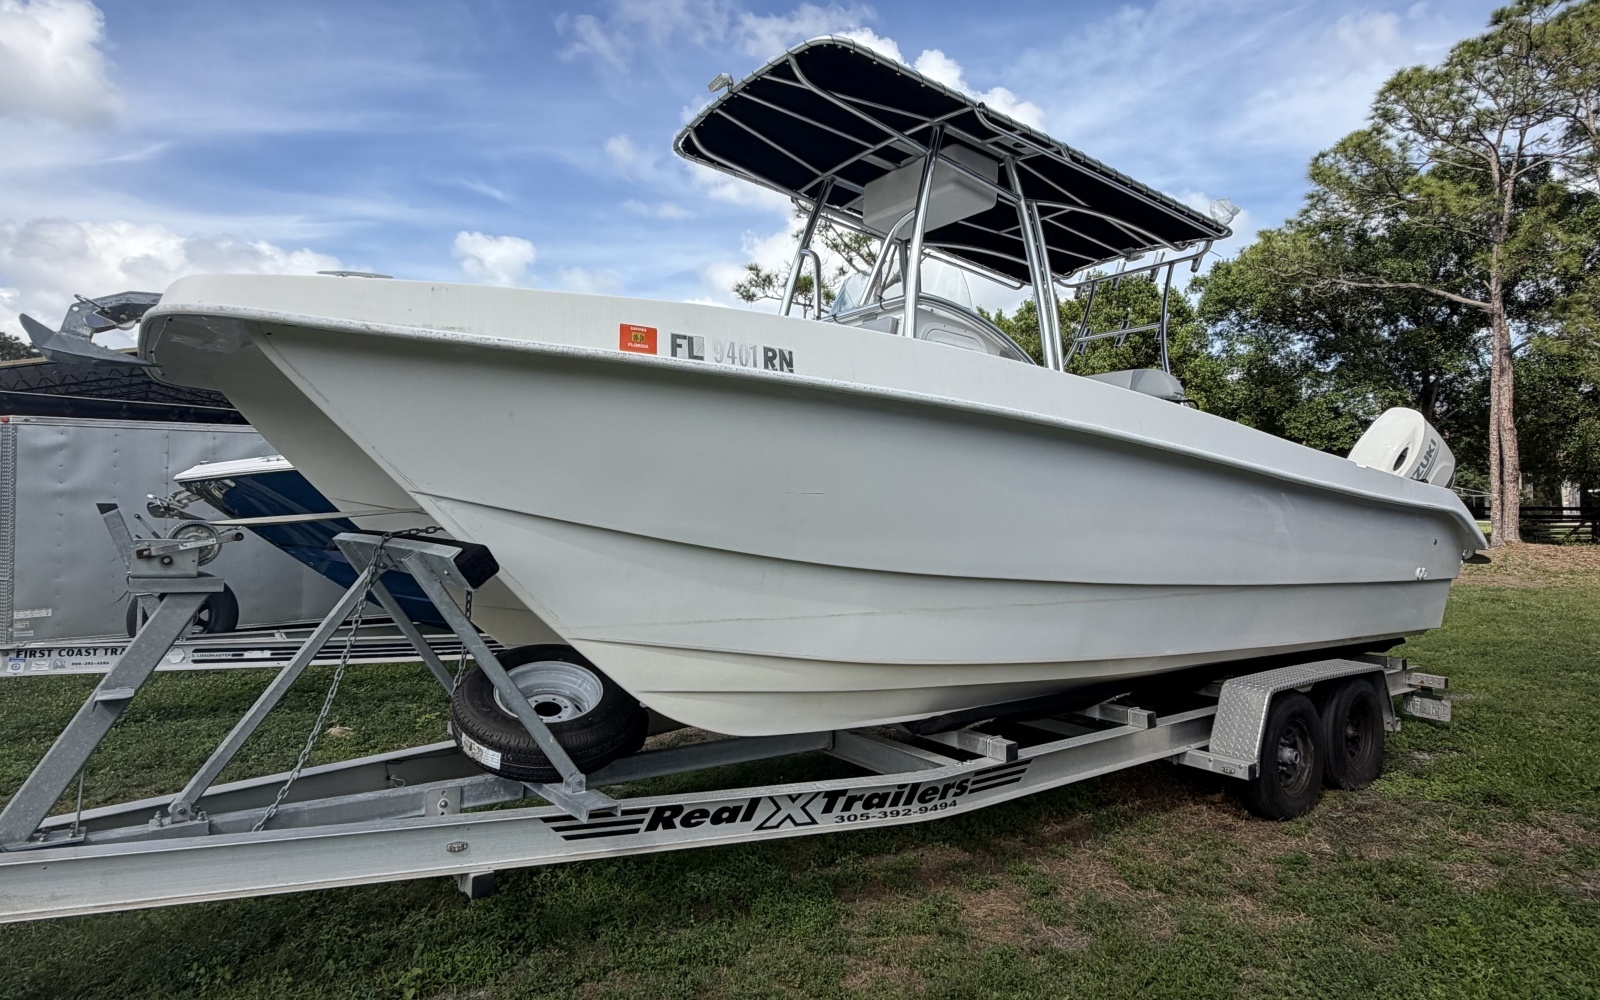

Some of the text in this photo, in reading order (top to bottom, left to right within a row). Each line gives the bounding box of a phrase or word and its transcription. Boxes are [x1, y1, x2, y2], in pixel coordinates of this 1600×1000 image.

[671, 333, 794, 373] FL 9401 RN
[1411, 438, 1437, 479] ZUKI
[16, 647, 126, 659] FIRST COAST TRA
[644, 778, 970, 832] Real X Trailers
[834, 800, 958, 823] 305-392-9494
